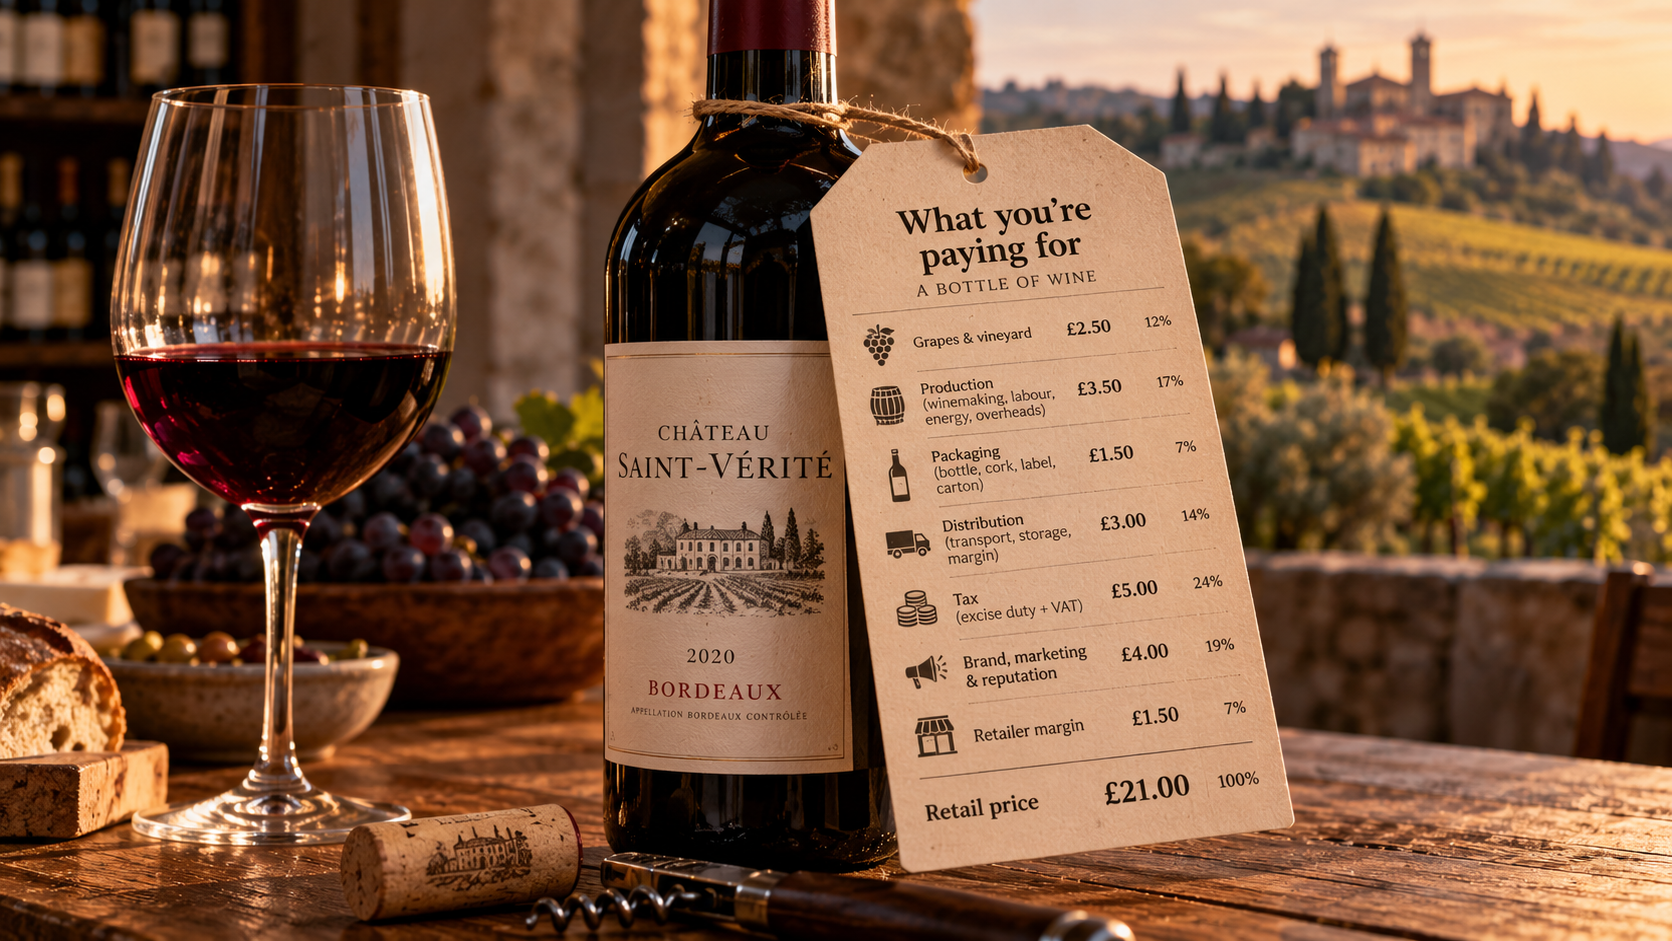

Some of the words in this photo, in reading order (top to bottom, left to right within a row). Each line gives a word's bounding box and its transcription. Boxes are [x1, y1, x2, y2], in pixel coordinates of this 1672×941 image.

[896, 207, 986, 234] What
[994, 198, 1091, 235] you’re
[919, 238, 1028, 275] paying
[1035, 231, 1081, 258] for
[917, 285, 928, 297] A
[936, 278, 1008, 295] BOTTLE
[1017, 275, 1039, 288] OF
[1047, 270, 1096, 285] WINE
[1067, 320, 1110, 336] £2.50
[1145, 315, 1171, 327] 12%
[913, 336, 959, 350] Grapes
[964, 332, 974, 344] &
[977, 327, 1032, 343] vineyard
[921, 379, 993, 394] Production
[1078, 379, 1121, 396] £3.50
[1157, 375, 1183, 387] 17%
[922, 392, 1007, 412] (winemaking,
[1011, 390, 1055, 402] labour,
[926, 414, 972, 426] energy,
[976, 403, 1045, 421] overheads)
[658, 420, 769, 441] CHÂTEAU
[932, 447, 1000, 462] Packaging
[1089, 445, 1133, 462] £1.50
[1176, 440, 1196, 453] 7%
[618, 451, 833, 479] SAINT-VÉRITÉ
[934, 463, 981, 481] (bottle,
[985, 460, 1017, 473] cork,
[1021, 456, 1055, 470] label,
[936, 479, 983, 494] carton)
[942, 515, 1024, 532] Distribution
[1101, 513, 1146, 531] £3.00
[1182, 508, 1209, 521] 14%
[945, 532, 1015, 551] (transport,
[1019, 528, 1071, 541] storage,
[947, 549, 998, 565] margin)
[1112, 580, 1157, 598] £5.00
[1193, 575, 1223, 589] 24%
[953, 593, 978, 605] Tax
[956, 608, 1002, 625] (excise
[1006, 605, 1035, 619] duty
[1040, 605, 1048, 613] +
[1051, 599, 1082, 613] VAT)
[1122, 643, 1168, 662] £4.00
[1206, 638, 1234, 652] 19%
[687, 649, 734, 664] 2020
[963, 652, 1010, 669] Brand,
[1015, 646, 1087, 663] marketing
[967, 675, 978, 687] &
[982, 668, 1057, 688] reputation
[649, 680, 782, 700] BORDEAUX
[688, 712, 741, 720] BORDEAUX
[1132, 707, 1178, 726] £1.50
[1224, 701, 1246, 714] 7%
[974, 725, 1030, 742] Retailer
[1035, 719, 1084, 736] margin
[1218, 771, 1259, 788] 100%
[1105, 774, 1189, 805] £21.00
[925, 798, 984, 821] Retail
[989, 795, 1039, 819] price
